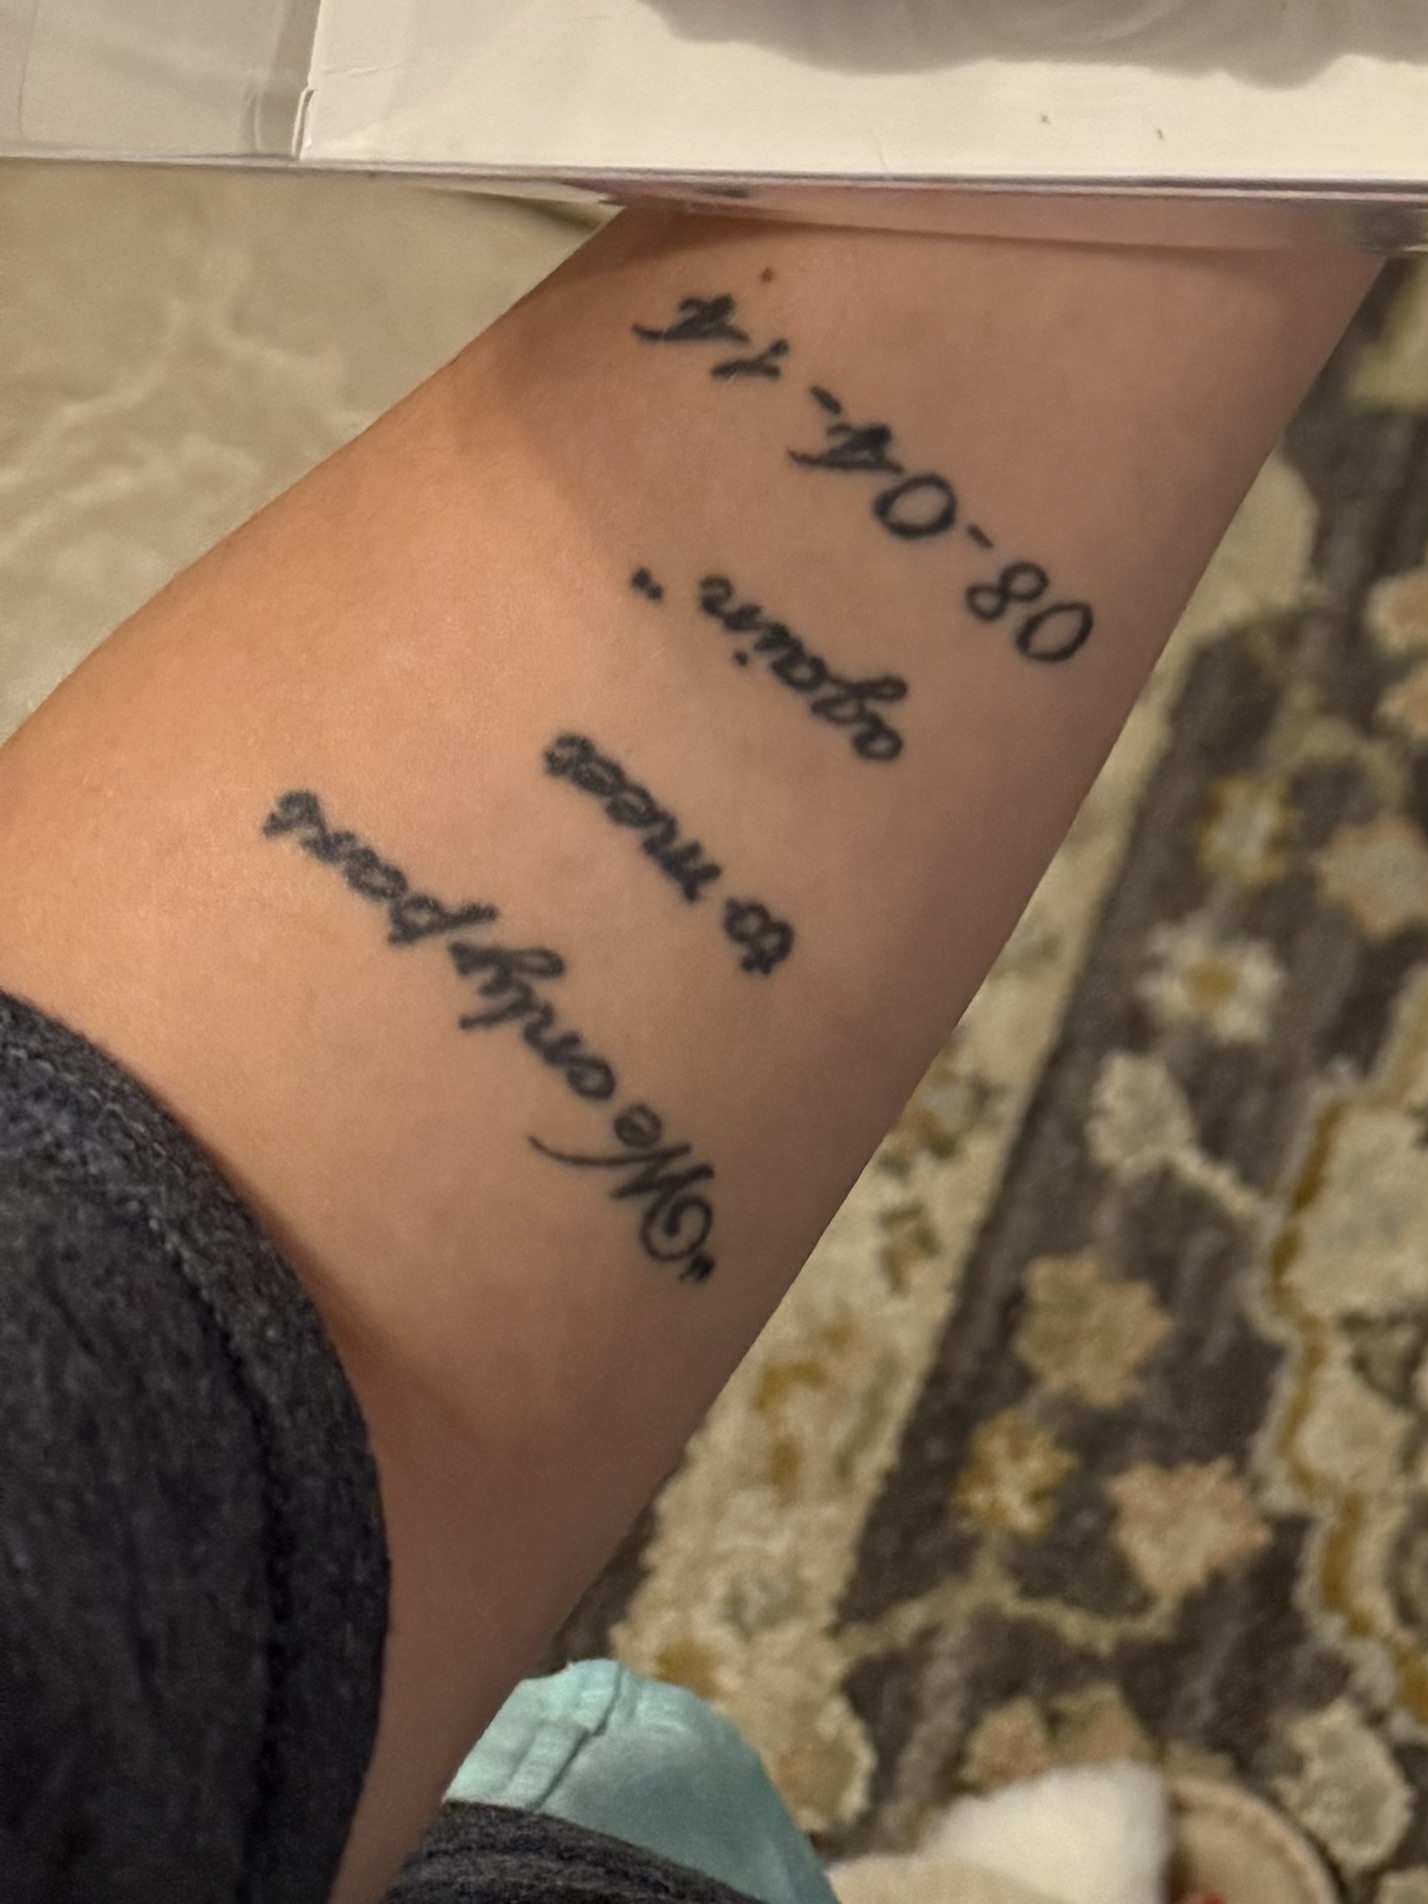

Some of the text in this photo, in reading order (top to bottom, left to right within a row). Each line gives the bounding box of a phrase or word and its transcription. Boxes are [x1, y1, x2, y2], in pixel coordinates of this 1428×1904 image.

[264, 789, 498, 947] part
[543, 732, 796, 976] to meet
[449, 938, 616, 1101] only
